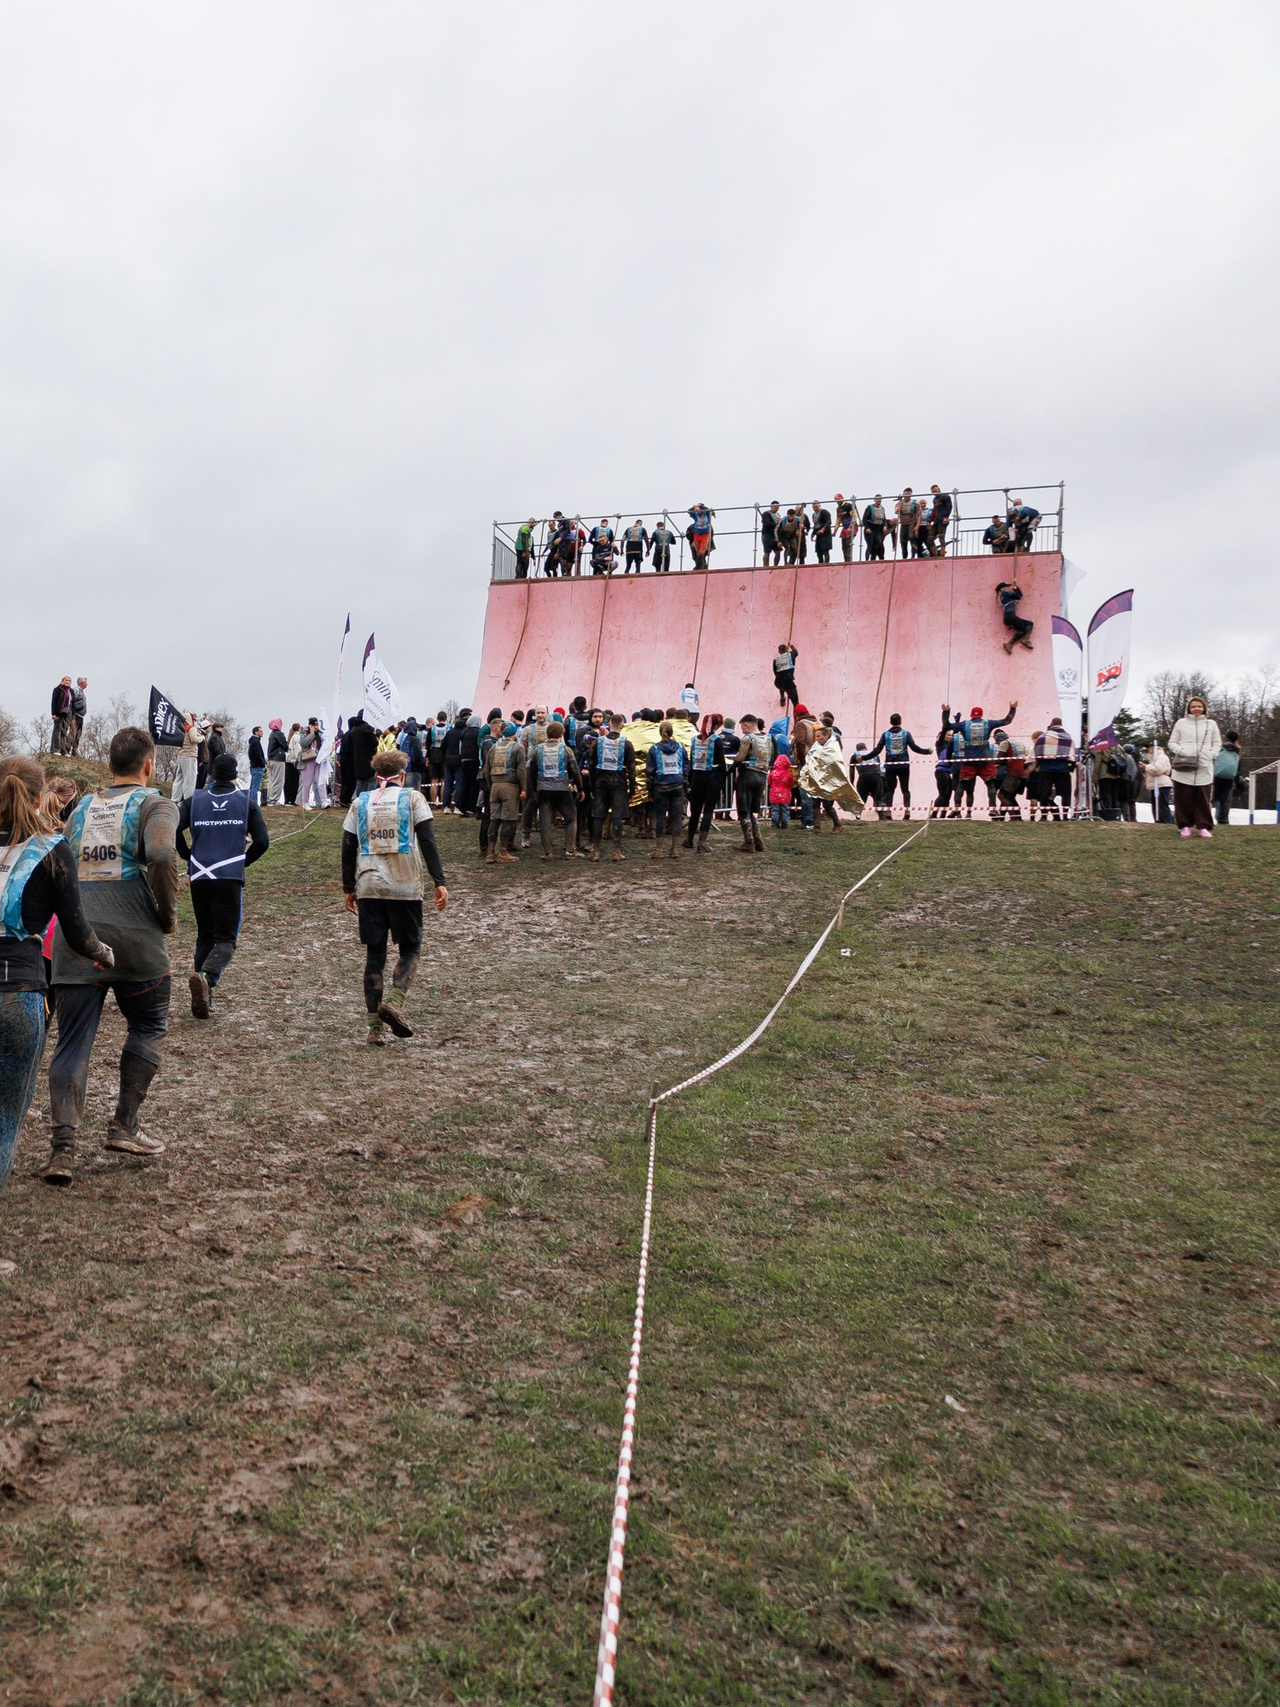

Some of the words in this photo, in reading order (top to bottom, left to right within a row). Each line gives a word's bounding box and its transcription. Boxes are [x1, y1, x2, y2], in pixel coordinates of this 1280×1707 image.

[194, 819, 244, 827] ИНСТРУКТОР
[370, 828, 396, 840] 5400
[82, 844, 118, 862] 5406
